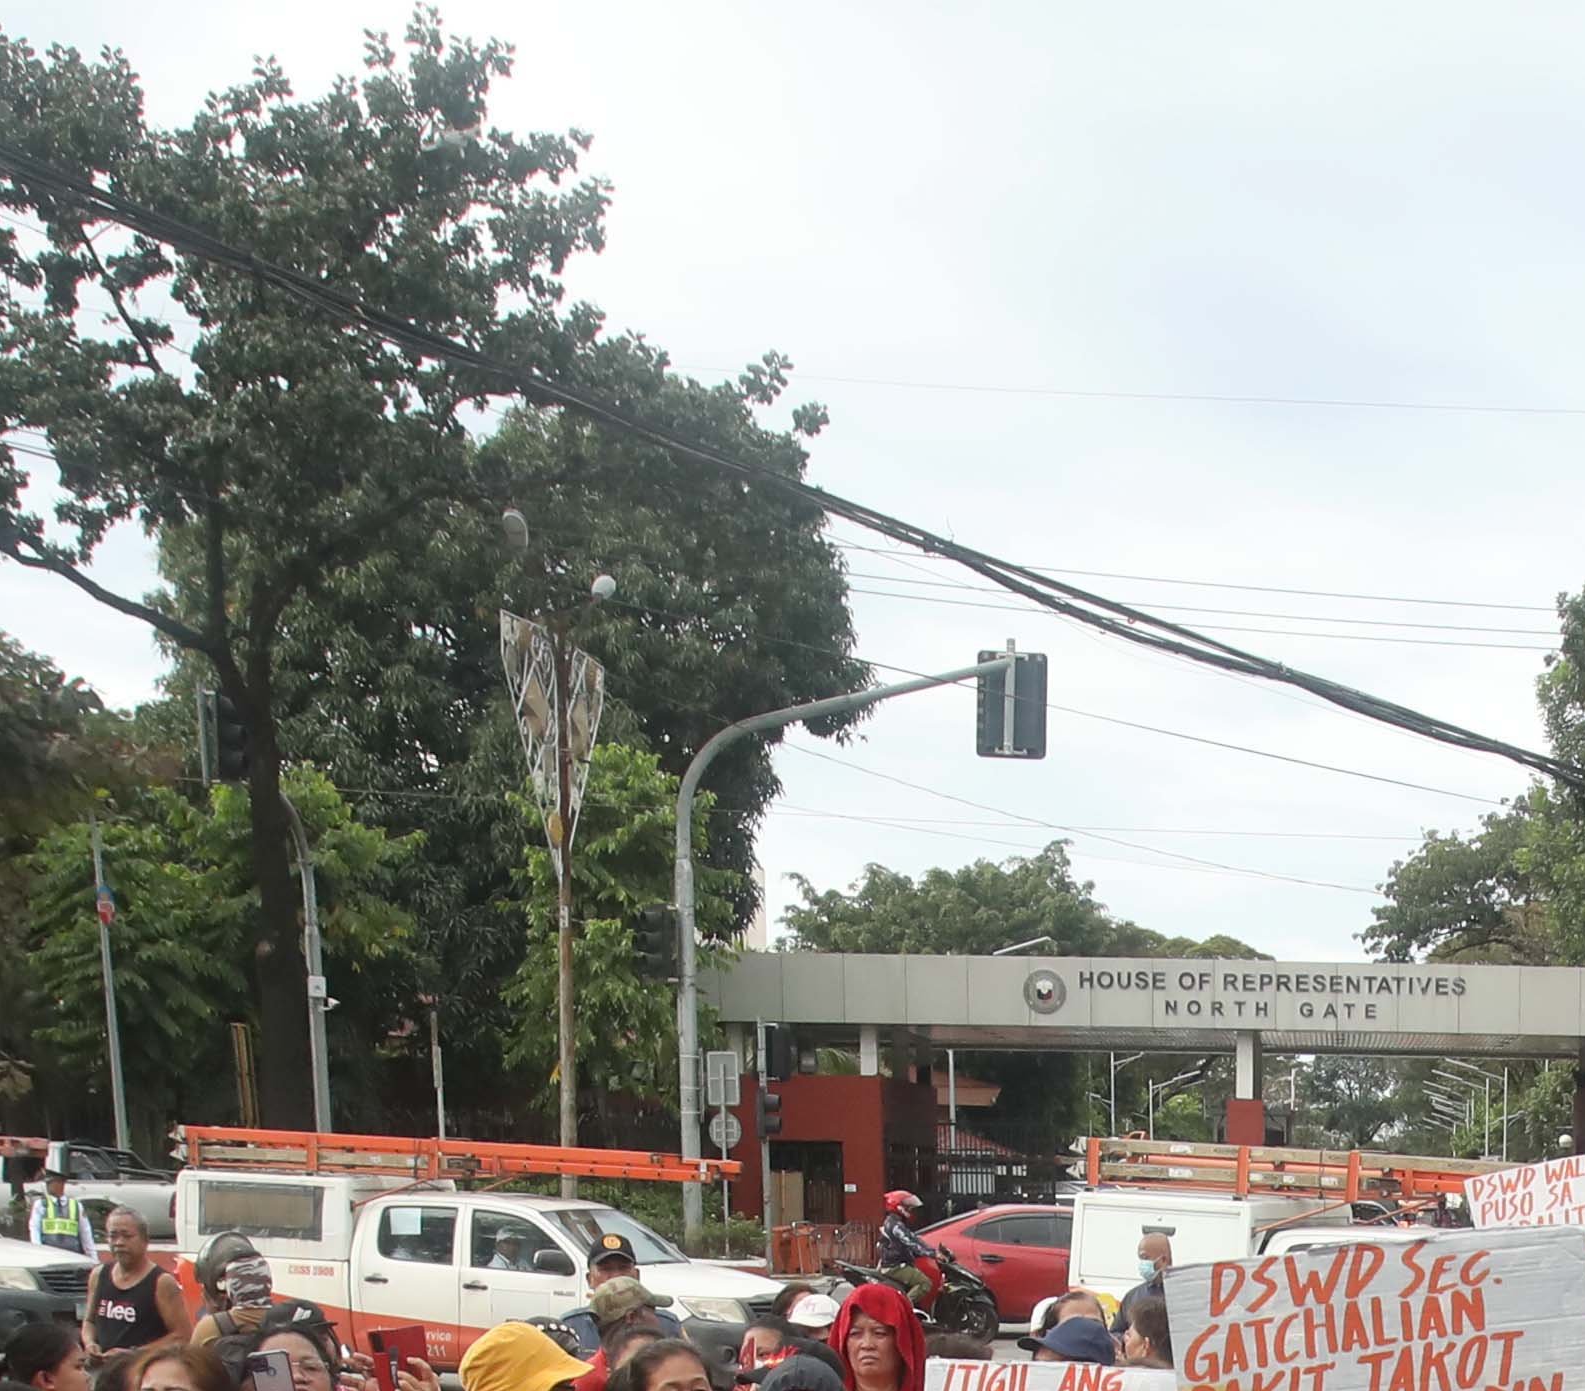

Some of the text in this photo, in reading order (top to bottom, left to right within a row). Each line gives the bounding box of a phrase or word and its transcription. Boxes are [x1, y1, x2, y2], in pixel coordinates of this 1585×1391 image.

[1079, 971, 1467, 996] HOUSE OF REPRESENTATIVES
[1165, 1000, 1377, 1019] NORTH GATE
[1472, 1168, 1535, 1201] DSWD
[1482, 1182, 1572, 1225] PUSO SA
[1210, 1240, 1502, 1316] DSWD SEC.
[1183, 1288, 1485, 1382] GATCHALIAN
